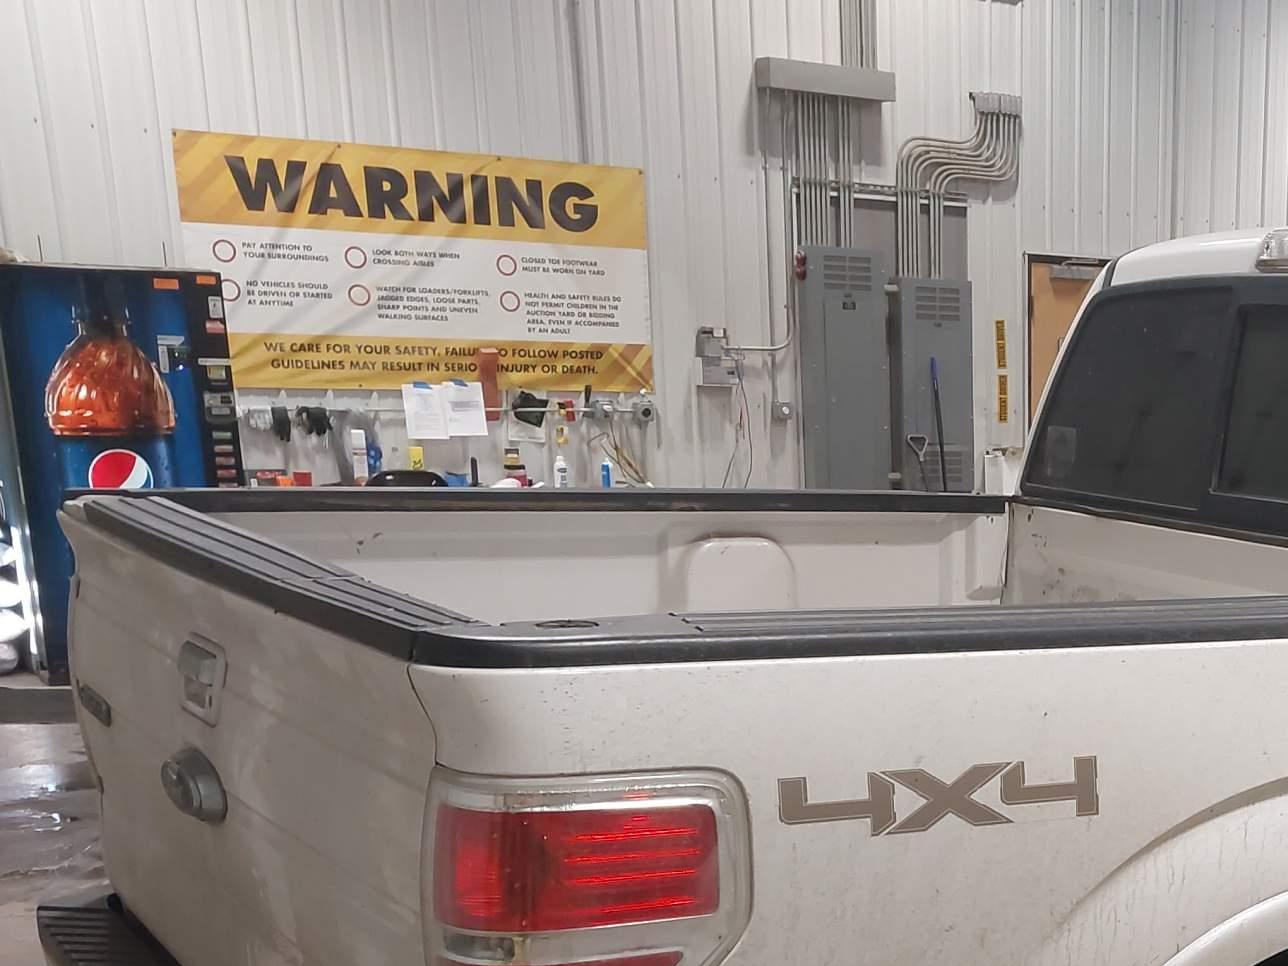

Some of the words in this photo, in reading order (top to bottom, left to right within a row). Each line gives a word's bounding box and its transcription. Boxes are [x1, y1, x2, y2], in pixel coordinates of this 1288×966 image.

[224, 155, 598, 233] WARNING
[260, 243, 300, 251] ATTENTION
[267, 252, 329, 262] SURROUNDINGS
[416, 251, 437, 259] WAYS
[373, 258, 410, 266] CROSSING
[521, 256, 546, 264] CLOSED
[562, 259, 597, 267] FOOTWEAR
[552, 267, 574, 275] WORN
[261, 281, 295, 289] VEHICLES
[297, 282, 328, 290] SHOULD
[258, 290, 287, 298] DRIVEN
[260, 299, 293, 307] ANYTIME
[566, 302, 598, 310] CHILDREN
[377, 303, 400, 311] SHARP
[403, 304, 429, 312] POINTS
[449, 306, 478, 314] UNEVEN
[264, 342, 286, 353] WE
[290, 342, 321, 353] CARE
[326, 343, 351, 354] FOR
[355, 344, 391, 355] YOUR
[445, 347, 480, 357] FAILU
[512, 349, 559, 360] FOLLOW
[563, 350, 604, 361] POSTED
[271, 359, 345, 370] GUIDELINES
[350, 361, 377, 371] MAY
[382, 361, 427, 372] RESULT
[427, 362, 440, 372] IN
[444, 362, 478, 372] SERIO
[497, 363, 537, 373] INJURY
[541, 364, 558, 374] OR
[561, 365, 599, 375] DEATH.
